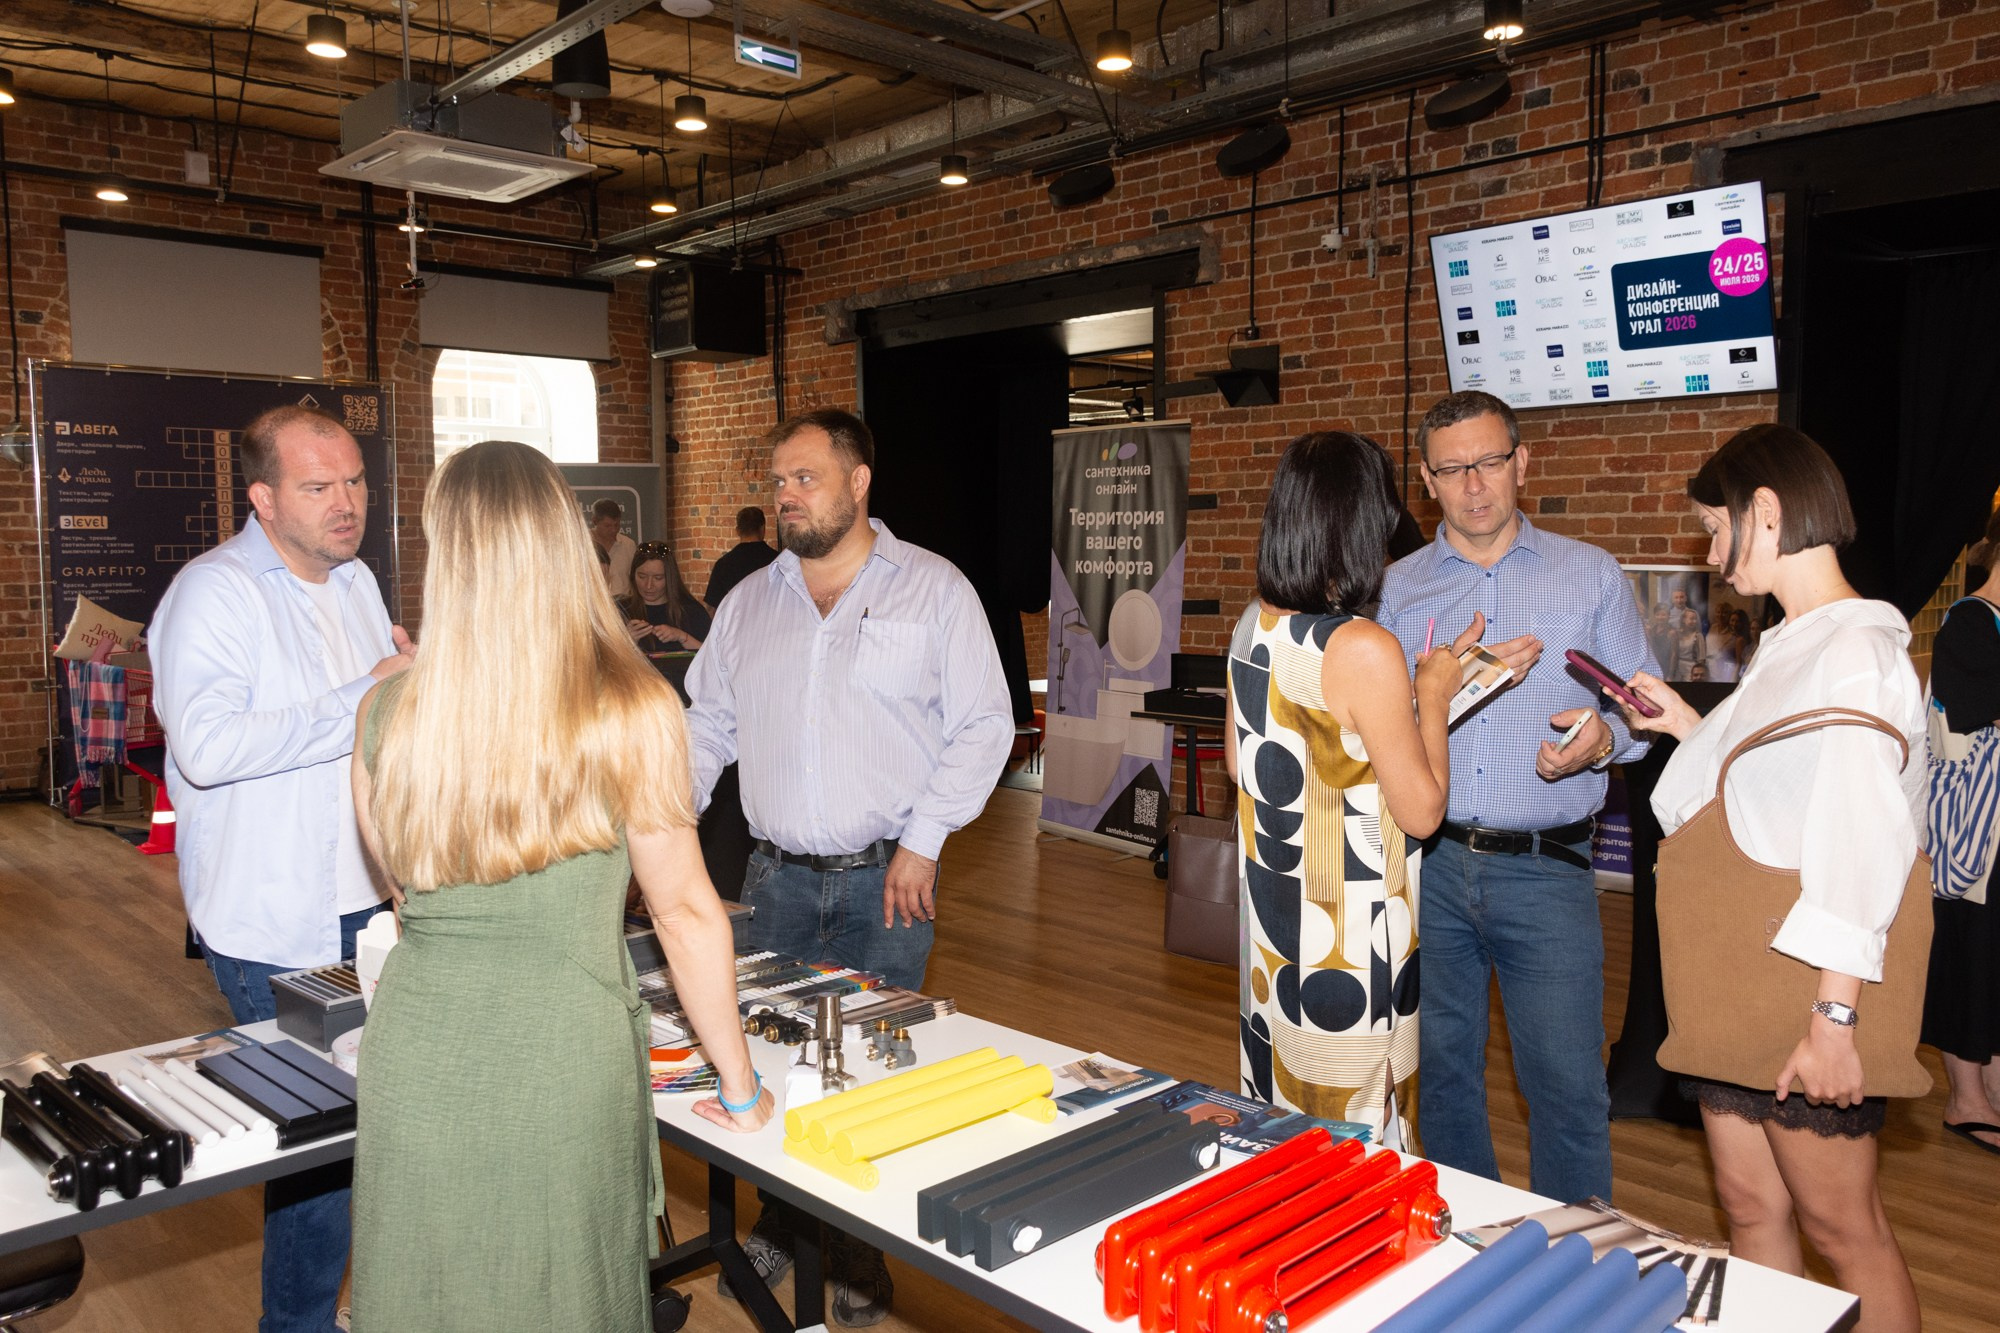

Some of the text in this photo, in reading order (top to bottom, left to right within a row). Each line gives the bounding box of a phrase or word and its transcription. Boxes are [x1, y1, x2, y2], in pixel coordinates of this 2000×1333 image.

[1713, 251, 1764, 276] 24/25
[1720, 273, 1760, 287] ИЮЛЯ 2026
[1626, 278, 1682, 302] ДИЗАЙН-
[1627, 292, 1720, 318] КОНФЕРЕНЦИЯ
[1629, 314, 1697, 336] УРАЛ 2026
[73, 424, 119, 436] АВЕГА
[75, 476, 112, 485] прима
[78, 467, 107, 476] Леди
[1085, 464, 1151, 479] сантехника
[1095, 479, 1138, 496] онлайн
[1069, 508, 1165, 531] Территория
[1085, 535, 1143, 550] вашего
[62, 566, 146, 577] GRAFFITO
[1075, 555, 1154, 580] комфорта
[89, 623, 123, 645] Леди
[1105, 826, 1157, 845] santehnika-online.ru
